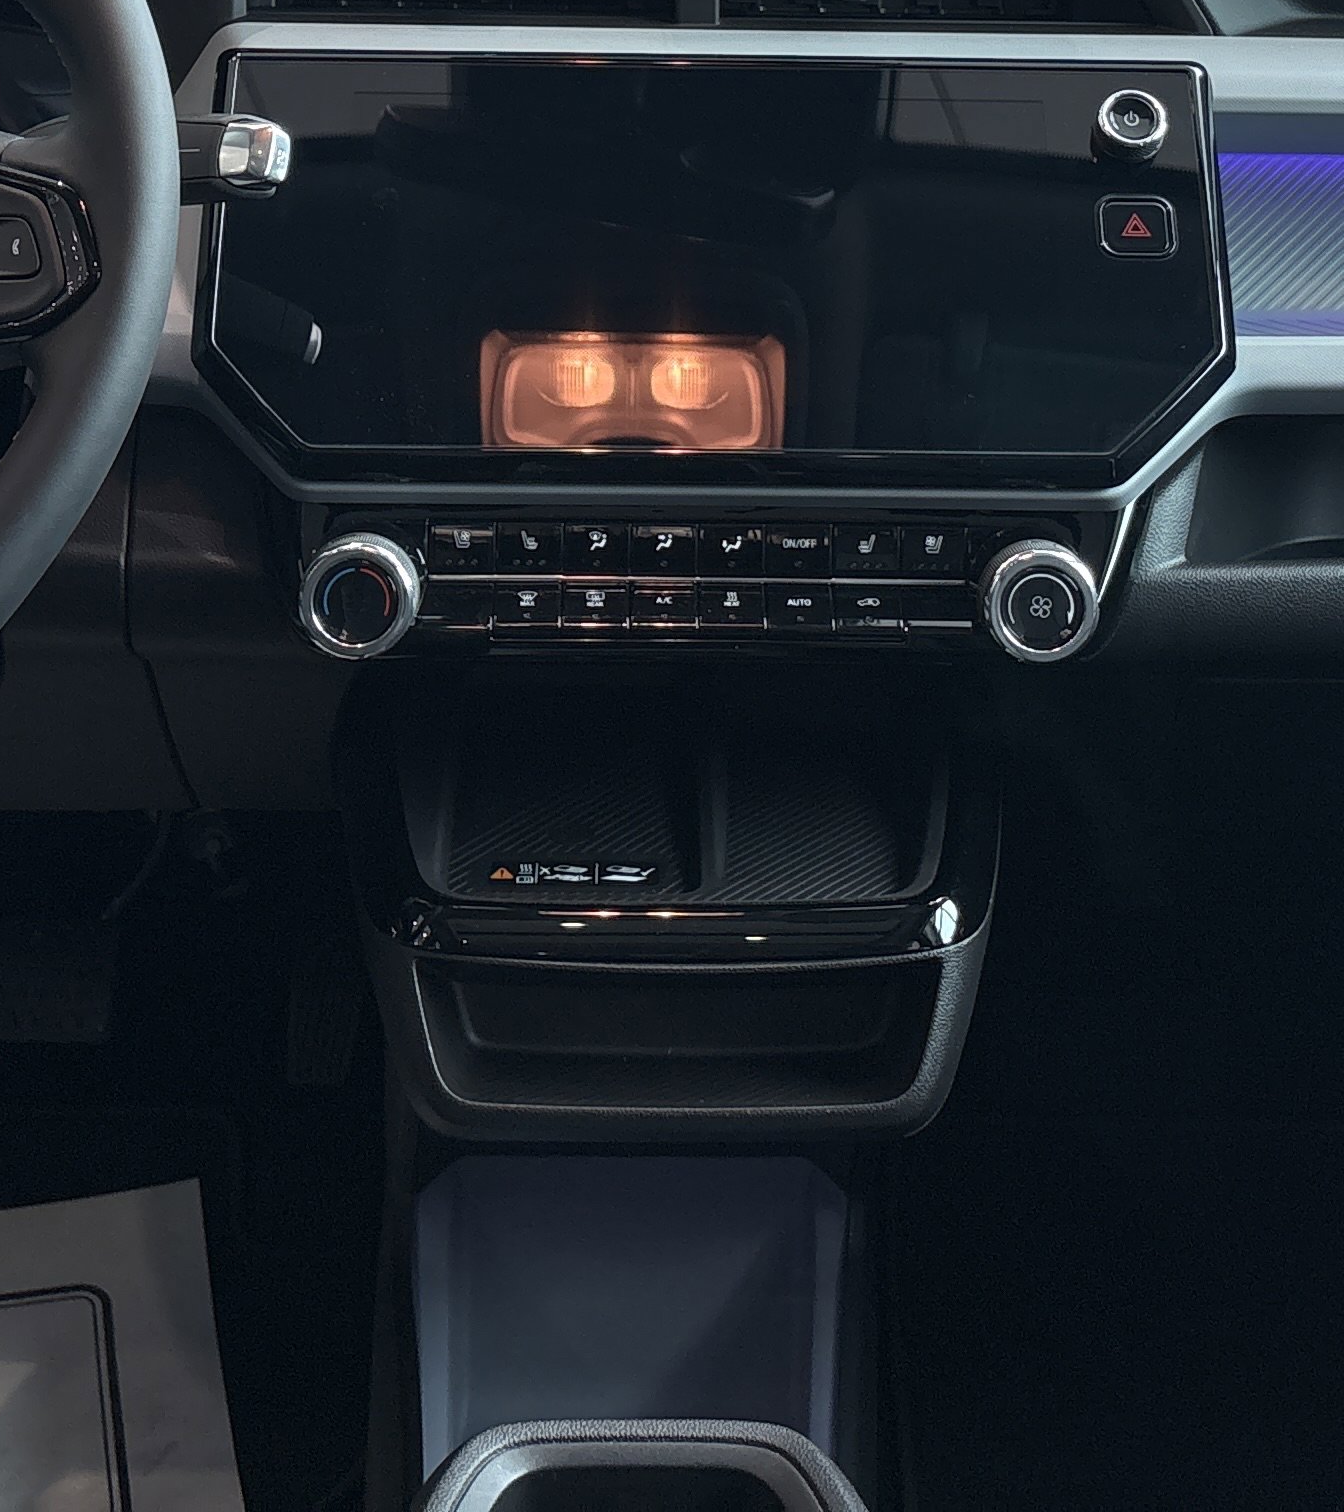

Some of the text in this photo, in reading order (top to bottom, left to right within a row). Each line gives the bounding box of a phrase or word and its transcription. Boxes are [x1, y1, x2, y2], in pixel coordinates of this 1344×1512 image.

[782, 538, 818, 549] ON/OFF
[656, 597, 673, 605] A/C
[786, 598, 812, 607] AUTO
